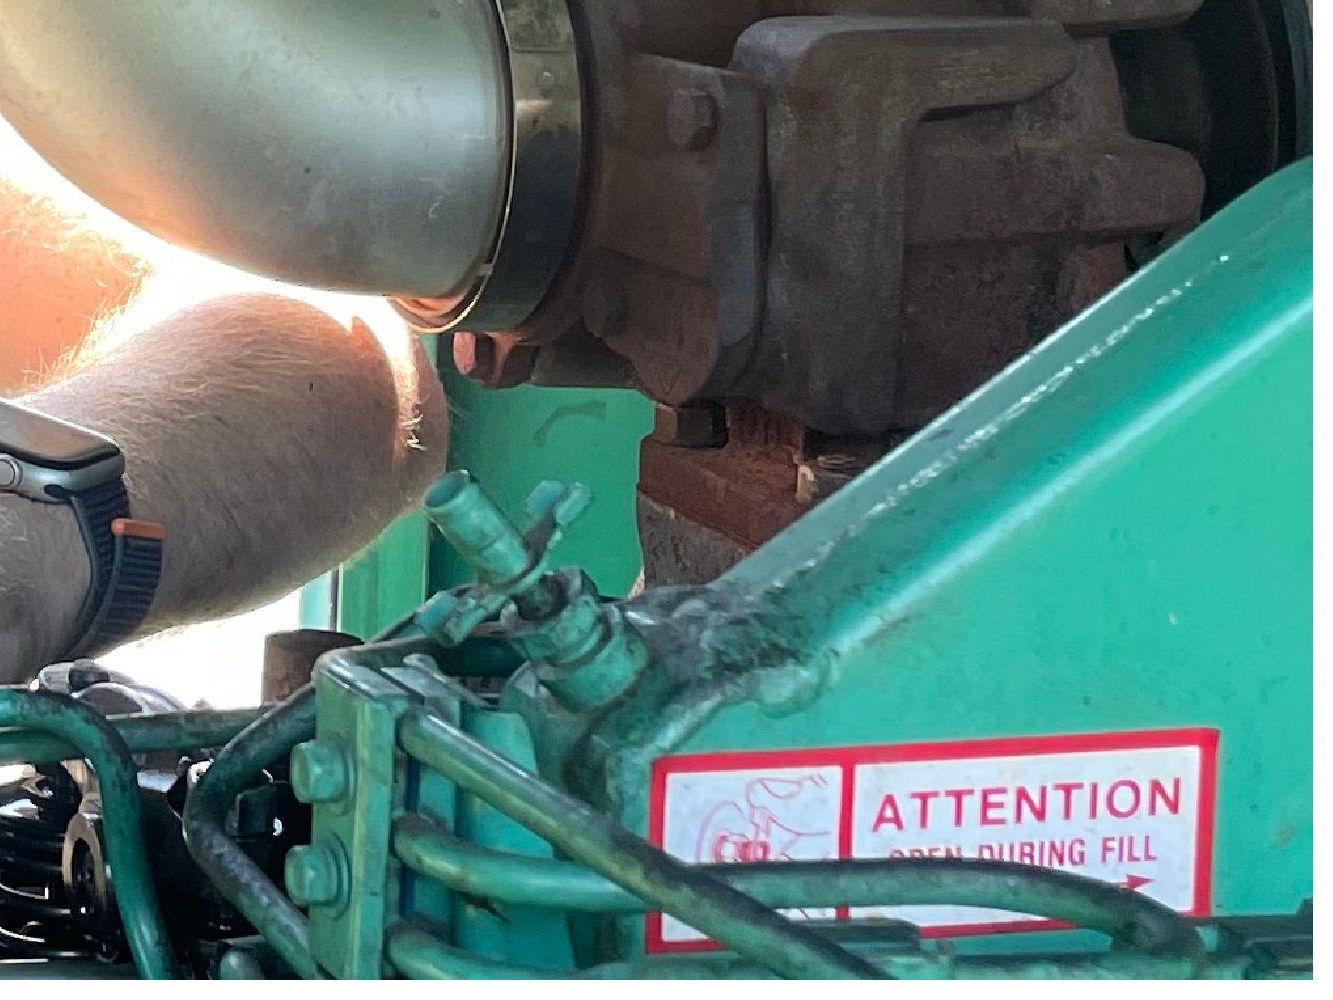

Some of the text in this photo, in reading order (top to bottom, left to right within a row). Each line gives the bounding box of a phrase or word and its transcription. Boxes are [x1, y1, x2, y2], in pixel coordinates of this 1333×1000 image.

[872, 777, 1181, 833] ATTENTION
[977, 838, 1085, 867] DURING
[1101, 835, 1157, 863] FILL
